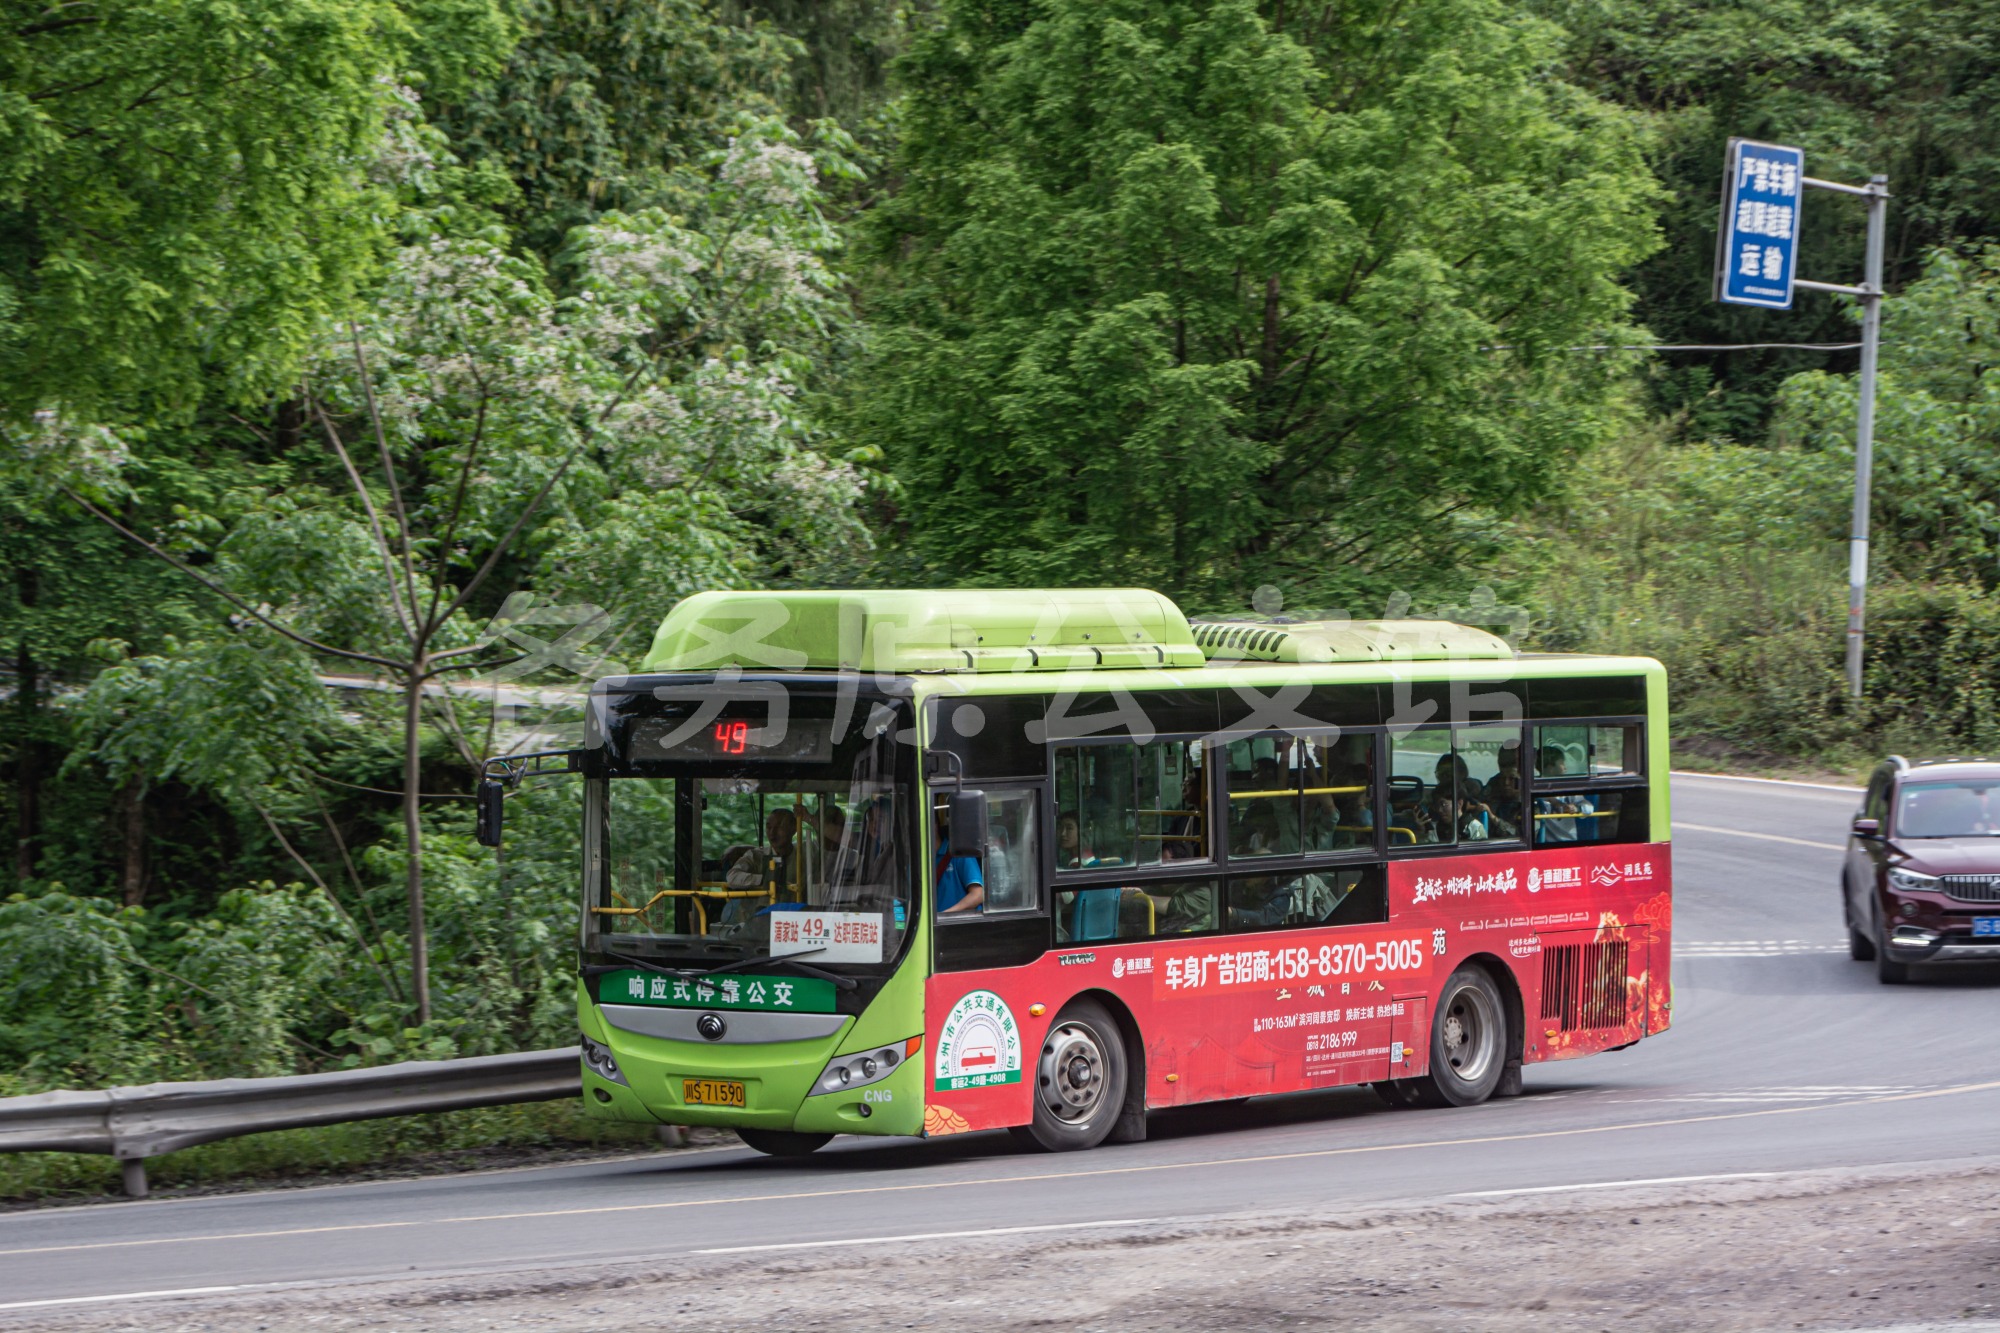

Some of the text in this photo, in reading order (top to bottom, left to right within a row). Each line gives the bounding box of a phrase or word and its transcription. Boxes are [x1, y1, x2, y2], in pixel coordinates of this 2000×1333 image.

[1739, 157, 1797, 197] 严禁车辆
[1736, 199, 1793, 239] 超限超载
[1738, 243, 1784, 281] 运输
[714, 721, 749, 755] 49
[628, 975, 794, 1007] 响应式停靠公交
[941, 994, 1017, 1077] 达州市公共交通有限公司
[1320, 1033, 1340, 1049] 2186
[1341, 1031, 1358, 1047] 999
[864, 1089, 893, 1103] CNG
